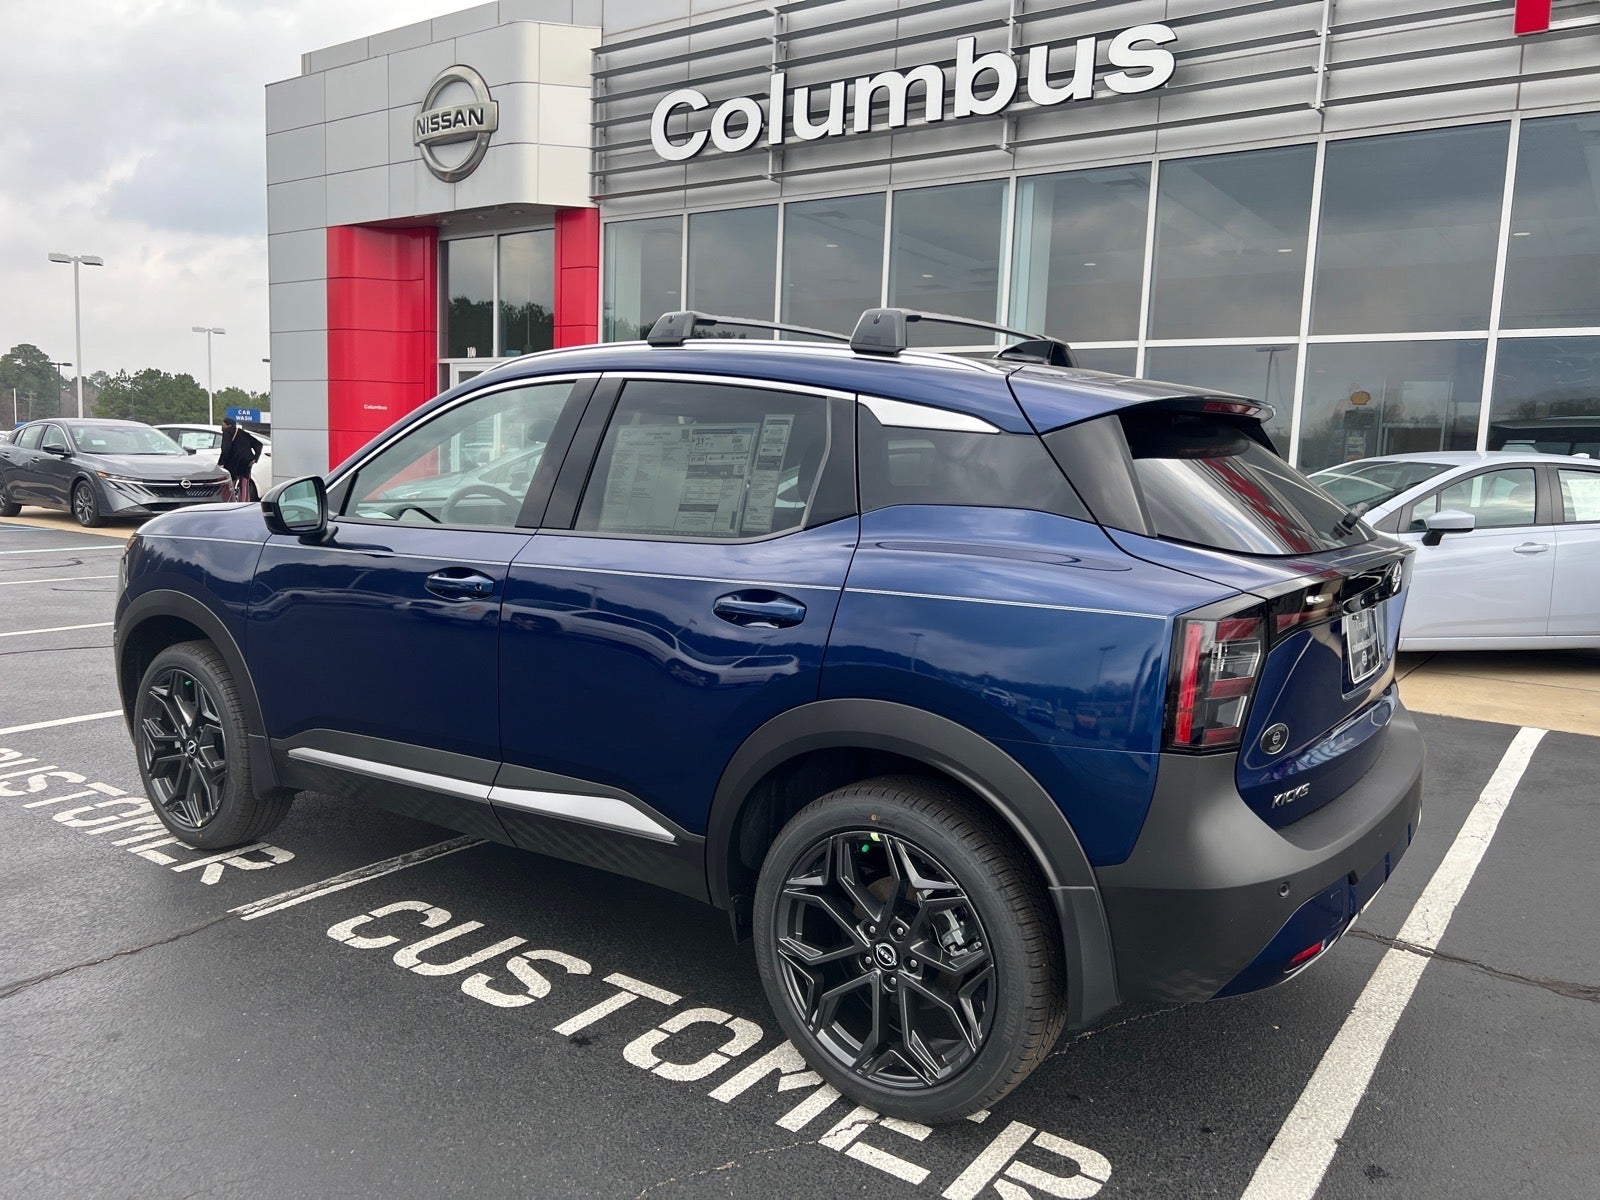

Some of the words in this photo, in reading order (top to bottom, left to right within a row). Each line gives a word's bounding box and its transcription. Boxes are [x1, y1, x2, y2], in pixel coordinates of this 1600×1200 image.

[416, 107, 485, 136] NISSAN
[650, 23, 1176, 161] Columbus
[1271, 782, 1311, 809] KICKS
[326, 899, 1113, 1200] CUSTOMER
